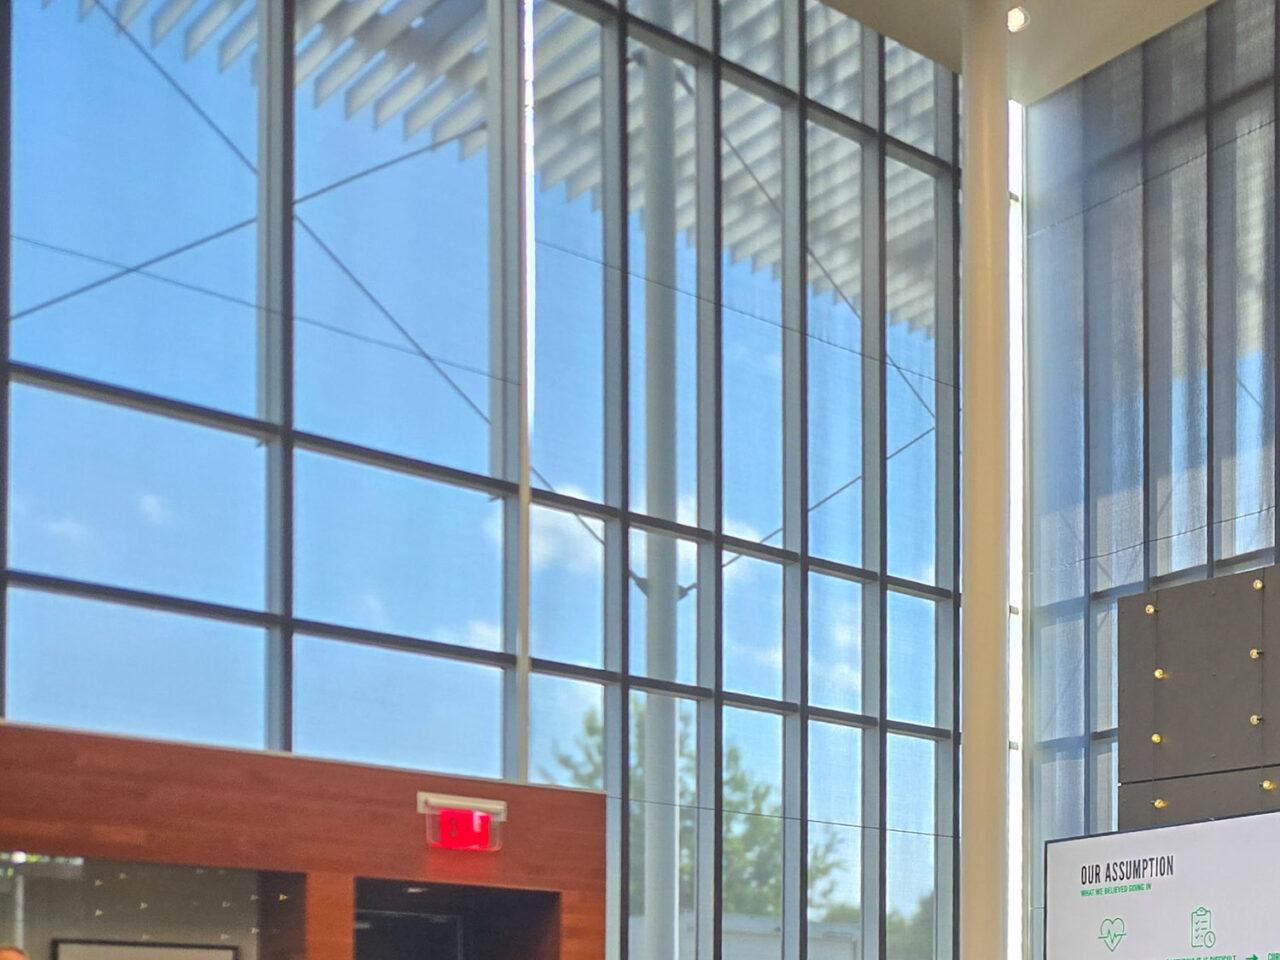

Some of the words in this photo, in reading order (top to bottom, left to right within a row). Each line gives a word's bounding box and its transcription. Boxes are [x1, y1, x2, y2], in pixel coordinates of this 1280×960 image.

[1081, 864, 1101, 885] OUR
[1105, 855, 1174, 882] ASSUMPTION
[1081, 889, 1094, 897] WHAT
[1104, 886, 1127, 895] BELIEVED
[1129, 884, 1144, 892] GOING
